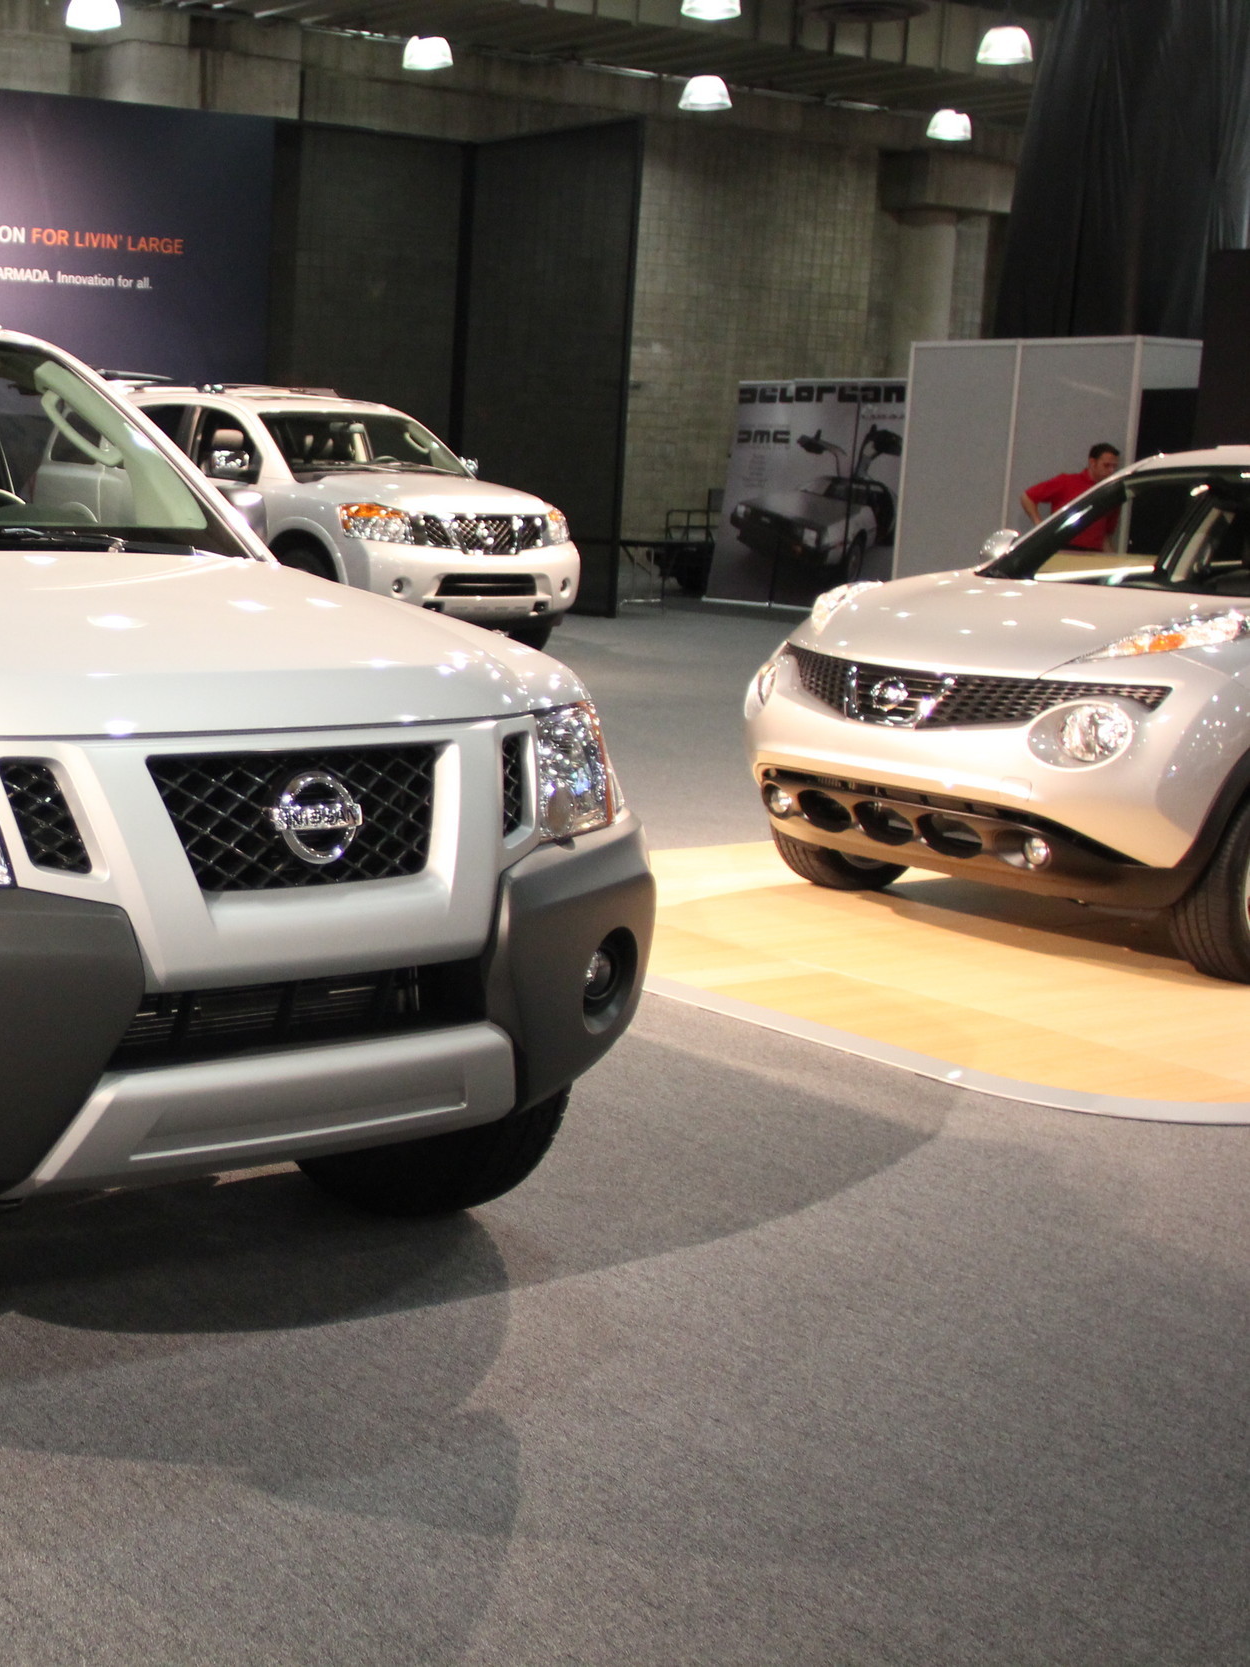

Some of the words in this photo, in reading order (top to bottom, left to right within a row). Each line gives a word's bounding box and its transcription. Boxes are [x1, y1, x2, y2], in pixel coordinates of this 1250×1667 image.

[31, 228, 69, 246] FOR
[74, 232, 124, 249] LIVIN'
[127, 236, 184, 254] LARGE
[56, 271, 115, 287] Innovation
[117, 275, 133, 289] for
[137, 278, 153, 290] all.
[285, 806, 356, 828] NISSAN
